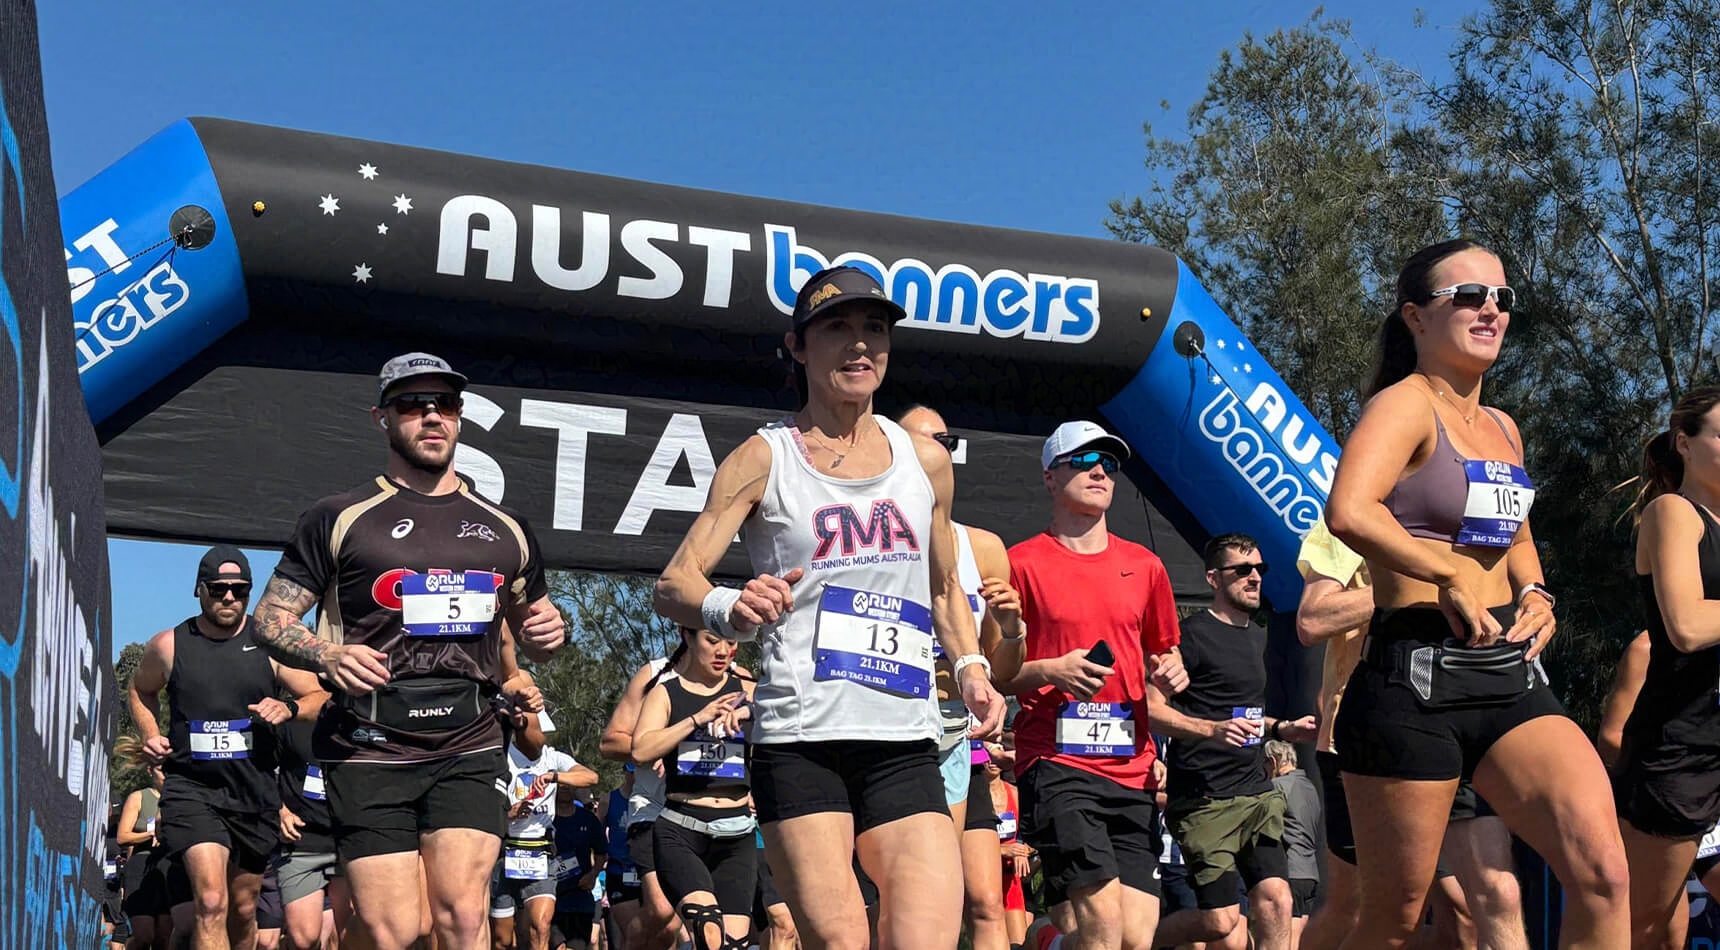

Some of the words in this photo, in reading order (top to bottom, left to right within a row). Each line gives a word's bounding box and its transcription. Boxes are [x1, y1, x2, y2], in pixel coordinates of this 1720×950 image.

[66, 218, 134, 304] ST
[436, 194, 751, 309] AUST
[1246, 382, 1339, 495] AUS
[1199, 387, 1323, 540] banne
[1493, 487, 1521, 517] 105
[811, 498, 921, 560] RMA
[811, 557, 851, 572] RUNNING
[852, 554, 880, 567] MUMS
[881, 553, 922, 564] AUSTRALIA
[439, 574, 465, 584] RUN
[447, 596, 461, 620] 5
[869, 594, 903, 611] RUN
[439, 623, 472, 633] 21.1KM
[866, 623, 899, 656] 13
[860, 656, 900, 675] 21.1KM
[830, 669, 847, 679] BAG
[848, 672, 864, 682] TAG
[408, 706, 454, 718] RUNLY
[1088, 703, 1111, 712] RUN
[1087, 722, 1112, 742] 47
[211, 735, 230, 751] 15
[700, 743, 726, 760] 150
[1084, 745, 1113, 754] 21.1KM
